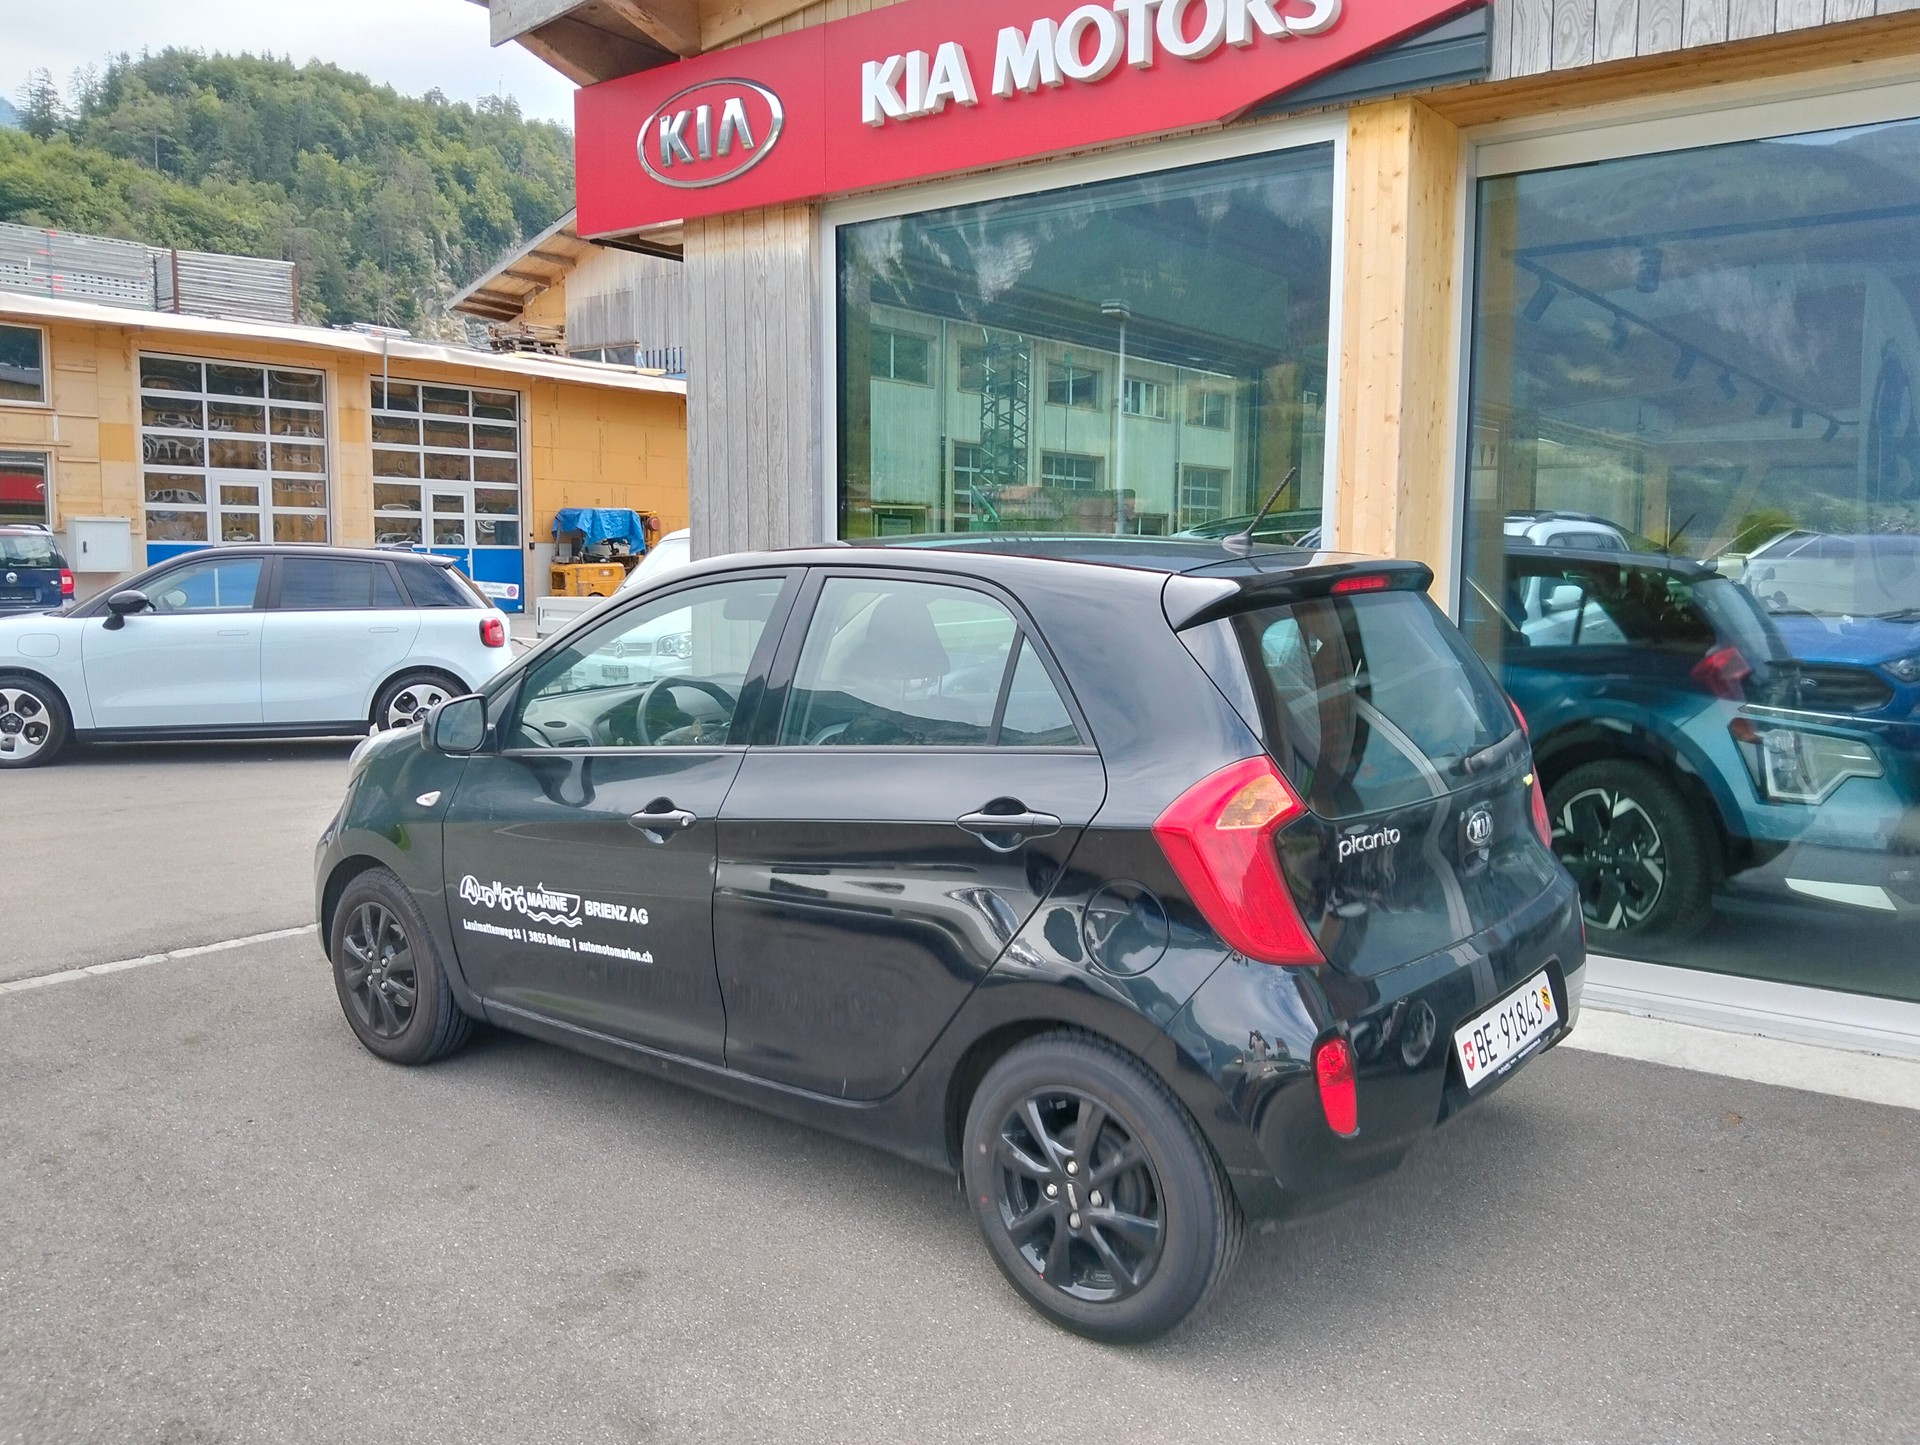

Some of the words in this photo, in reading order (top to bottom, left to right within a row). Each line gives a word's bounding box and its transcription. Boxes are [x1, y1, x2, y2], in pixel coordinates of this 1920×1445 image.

[862, 41, 978, 127] KIA
[659, 97, 755, 167] KIA
[1339, 827, 1401, 863] picanto
[1472, 816, 1491, 840] KIA
[527, 892, 568, 912] MARINE
[585, 900, 628, 922] BRIENZ
[629, 907, 649, 925] AG
[513, 928, 522, 939] 11
[528, 930, 547, 944] 3855
[547, 933, 571, 949] Brienz
[579, 941, 653, 963] automotomarine.ch
